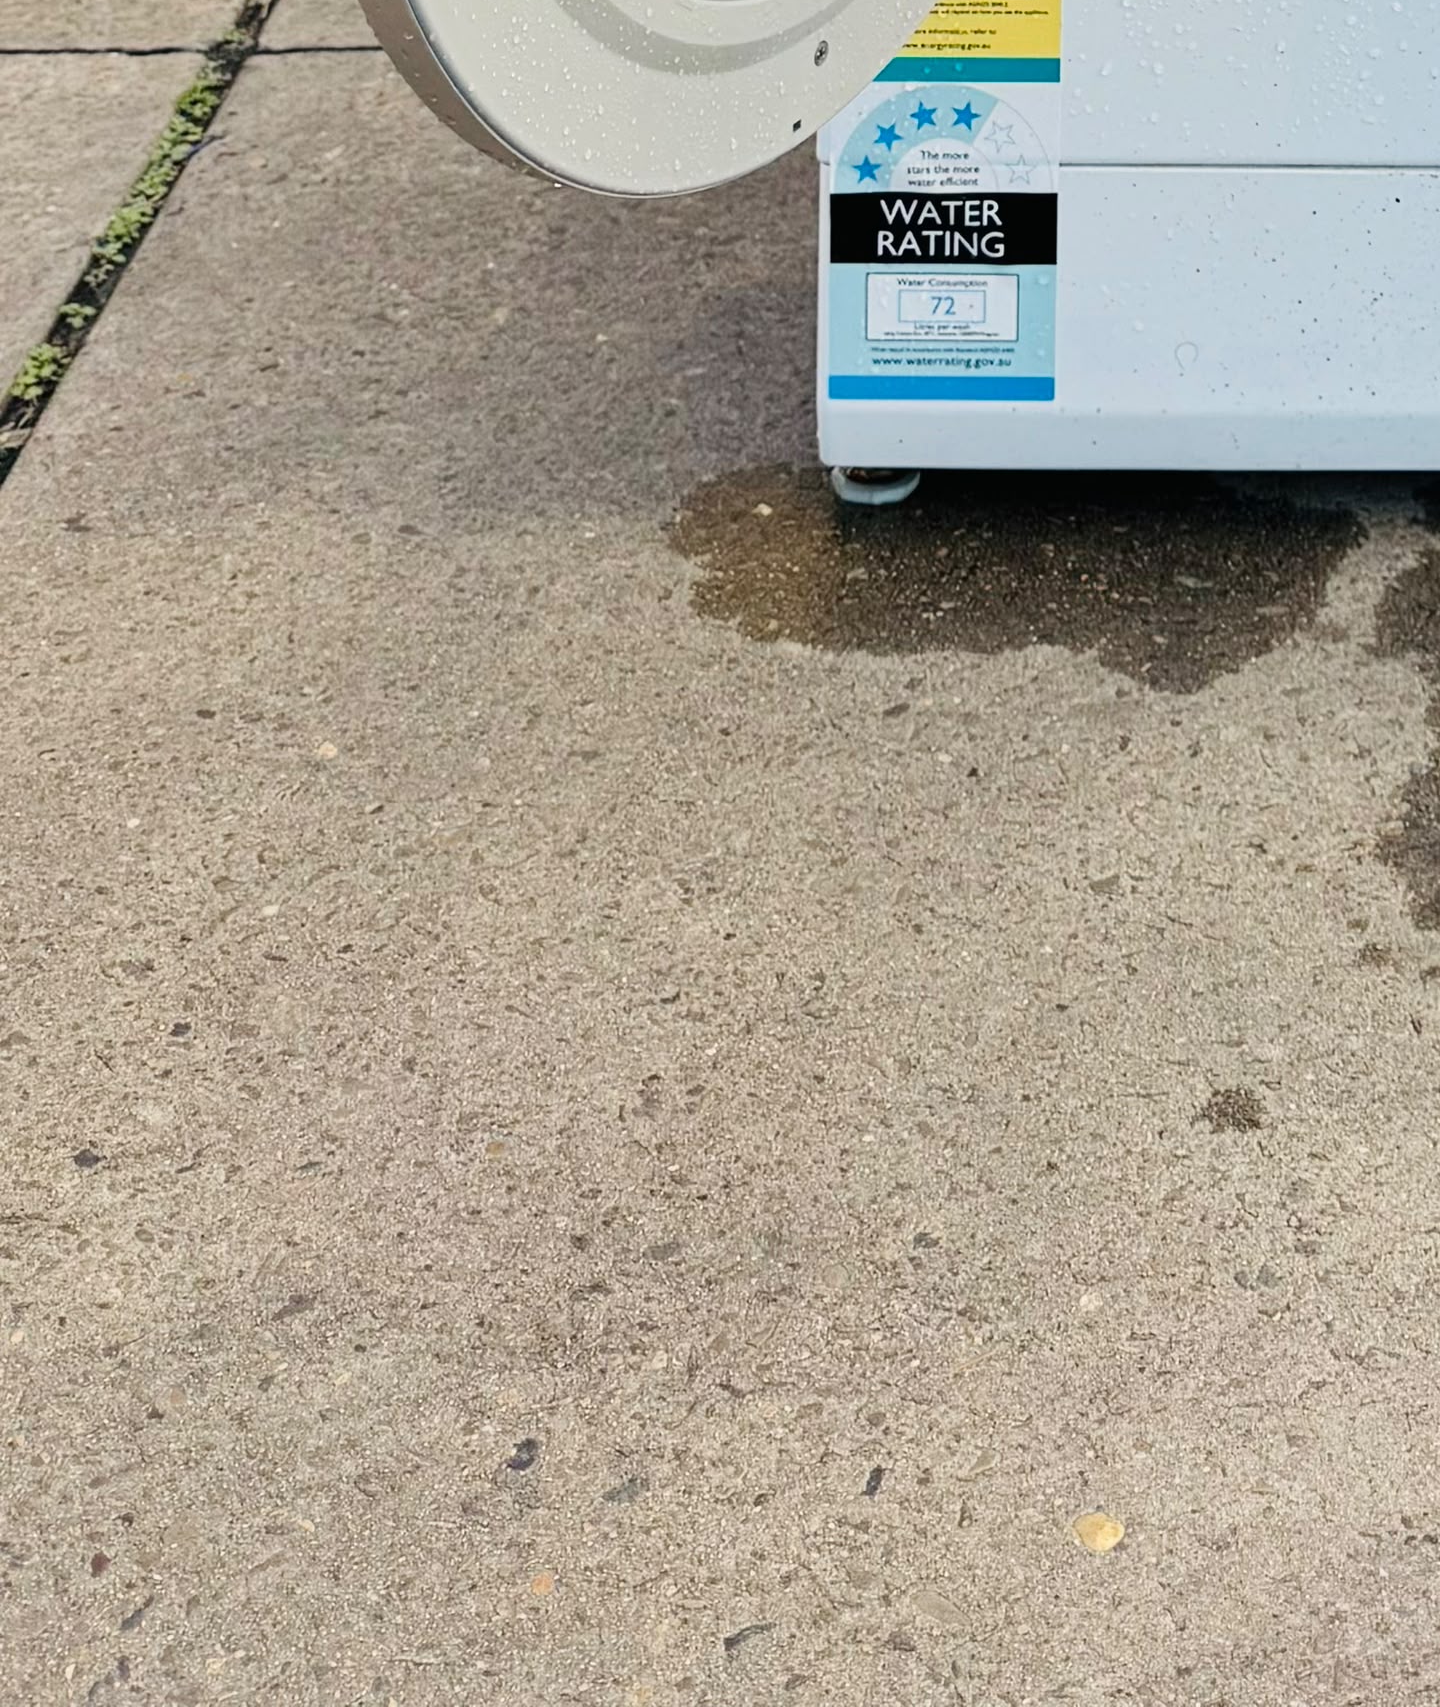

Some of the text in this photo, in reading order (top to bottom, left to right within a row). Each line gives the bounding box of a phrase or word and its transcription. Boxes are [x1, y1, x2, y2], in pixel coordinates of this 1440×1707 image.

[920, 149, 969, 160] The more
[907, 166, 930, 175] stars
[934, 163, 950, 174] the
[908, 177, 979, 187] water efficient
[880, 199, 1002, 227] WATER
[876, 230, 1005, 258] RATING
[897, 277, 988, 288] Water Consumption
[931, 296, 956, 316] 72
[872, 357, 1012, 369] www.waterrating.gov.au
